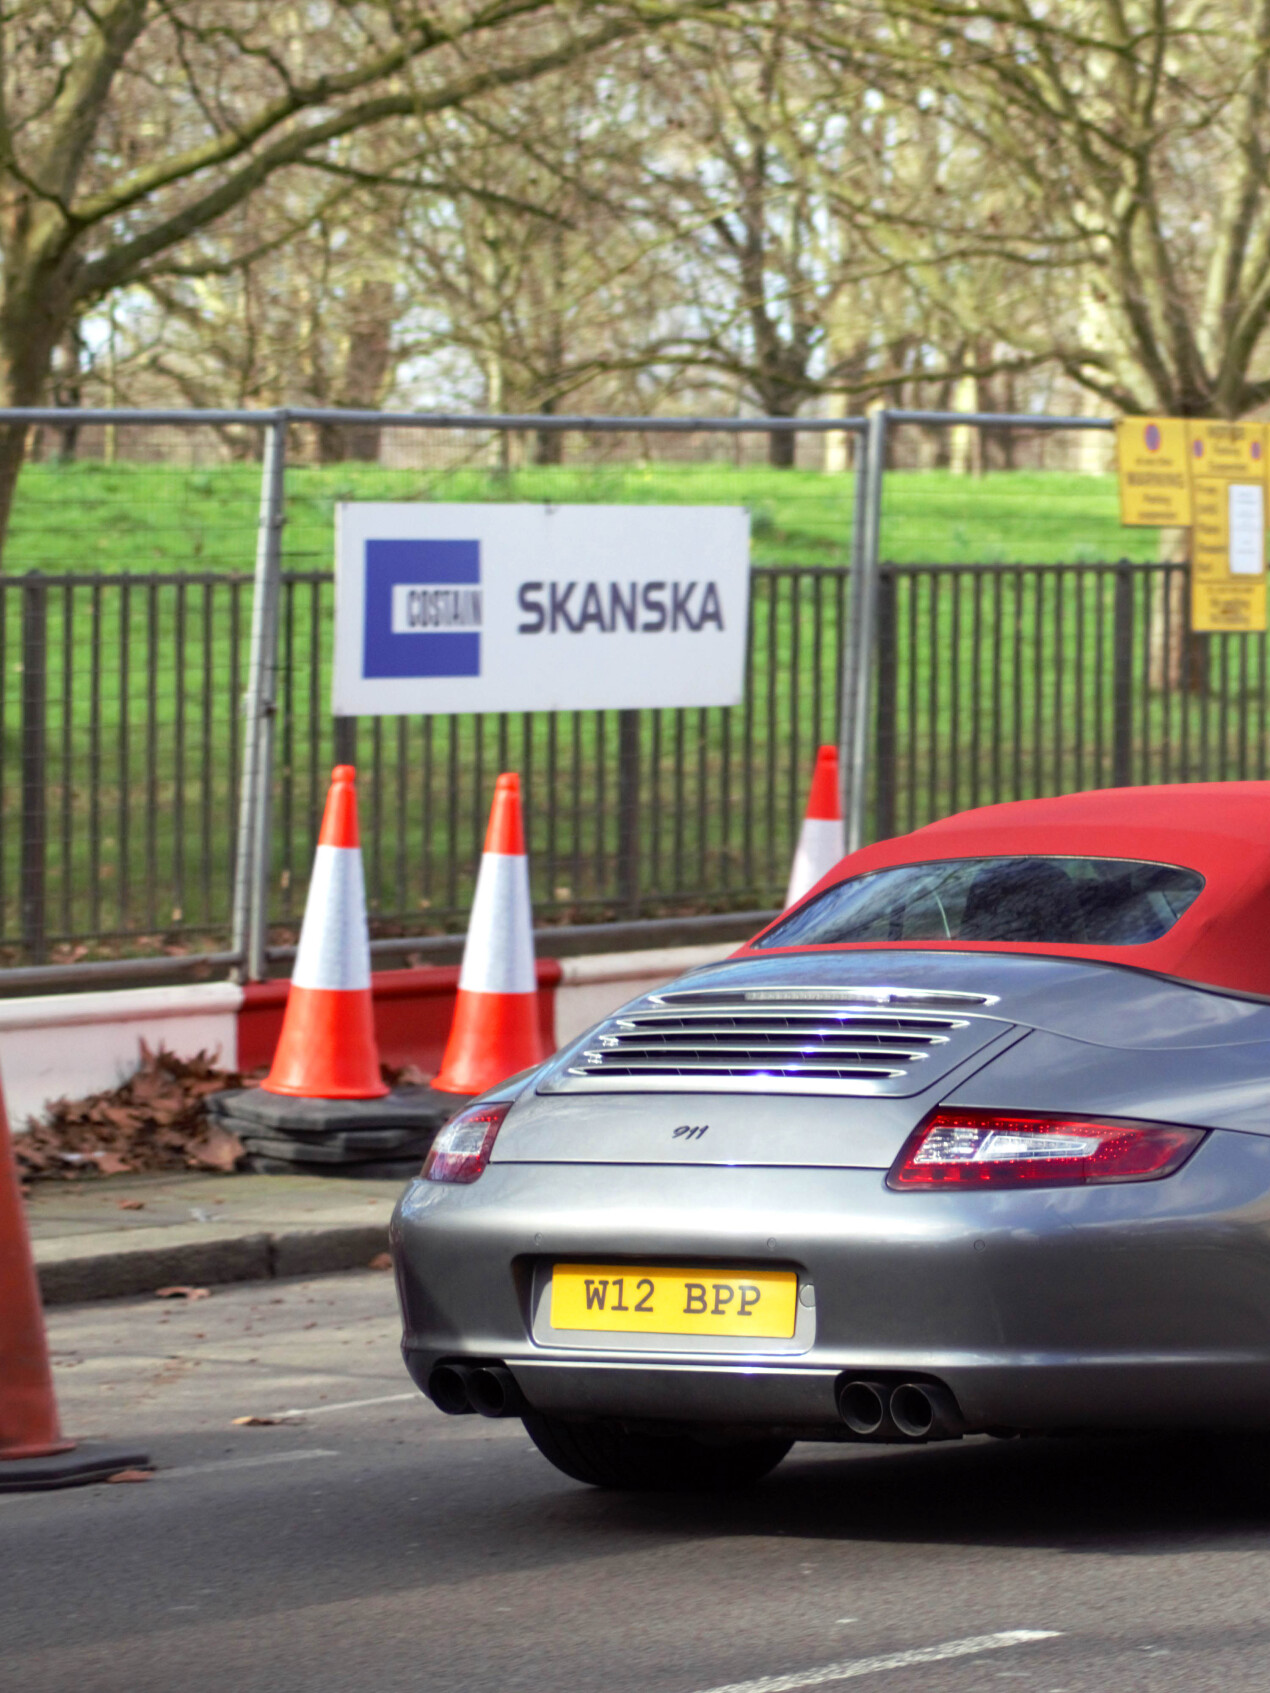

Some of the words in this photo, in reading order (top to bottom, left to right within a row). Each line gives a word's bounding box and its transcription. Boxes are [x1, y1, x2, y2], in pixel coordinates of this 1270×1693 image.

[407, 589, 483, 628] COSTAIN
[518, 581, 725, 634] SKANSKA
[672, 1124, 709, 1140] 911
[584, 1277, 655, 1313] W12
[683, 1282, 762, 1316] BPP
